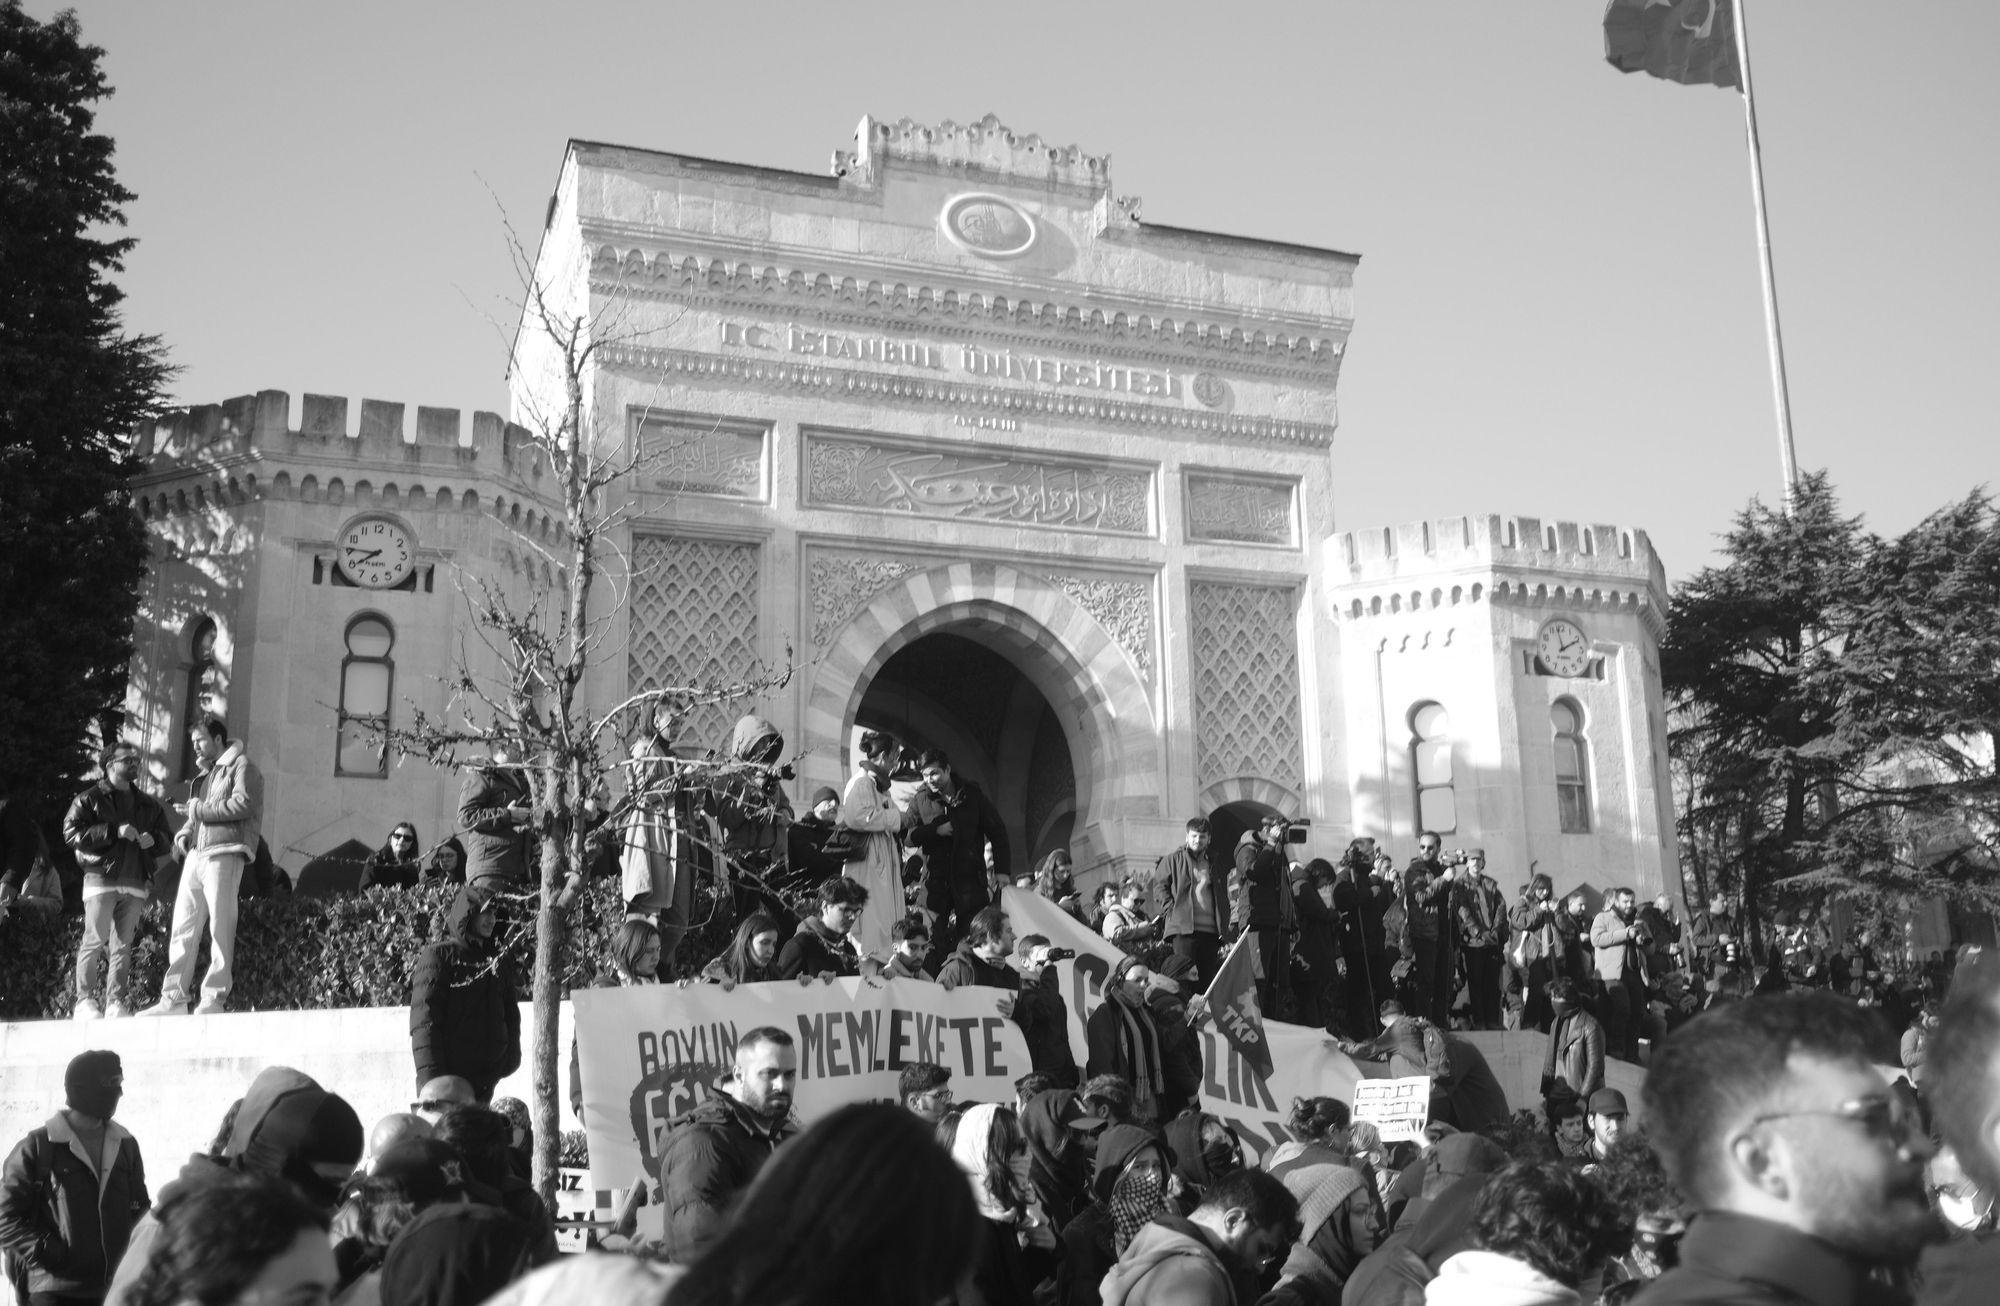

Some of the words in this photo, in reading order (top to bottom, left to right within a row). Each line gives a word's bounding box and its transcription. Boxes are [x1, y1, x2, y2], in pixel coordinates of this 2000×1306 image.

[787, 322, 945, 369] İSTANBUL
[960, 343, 1174, 396] ÜNİVERSİTESİ
[362, 526, 367, 535] 11
[375, 525, 384, 534] 12
[350, 535, 358, 544] 10
[397, 538, 404, 548] 2
[400, 551, 408, 561] 3
[394, 564, 402, 572] 4
[359, 569, 365, 578] 7
[385, 572, 392, 580] 5
[371, 574, 378, 583] 6
[1221, 1004, 1259, 1045] TKP
[638, 1020, 738, 1077] BOYUN
[797, 1009, 1008, 1080] MEMLEKETE
